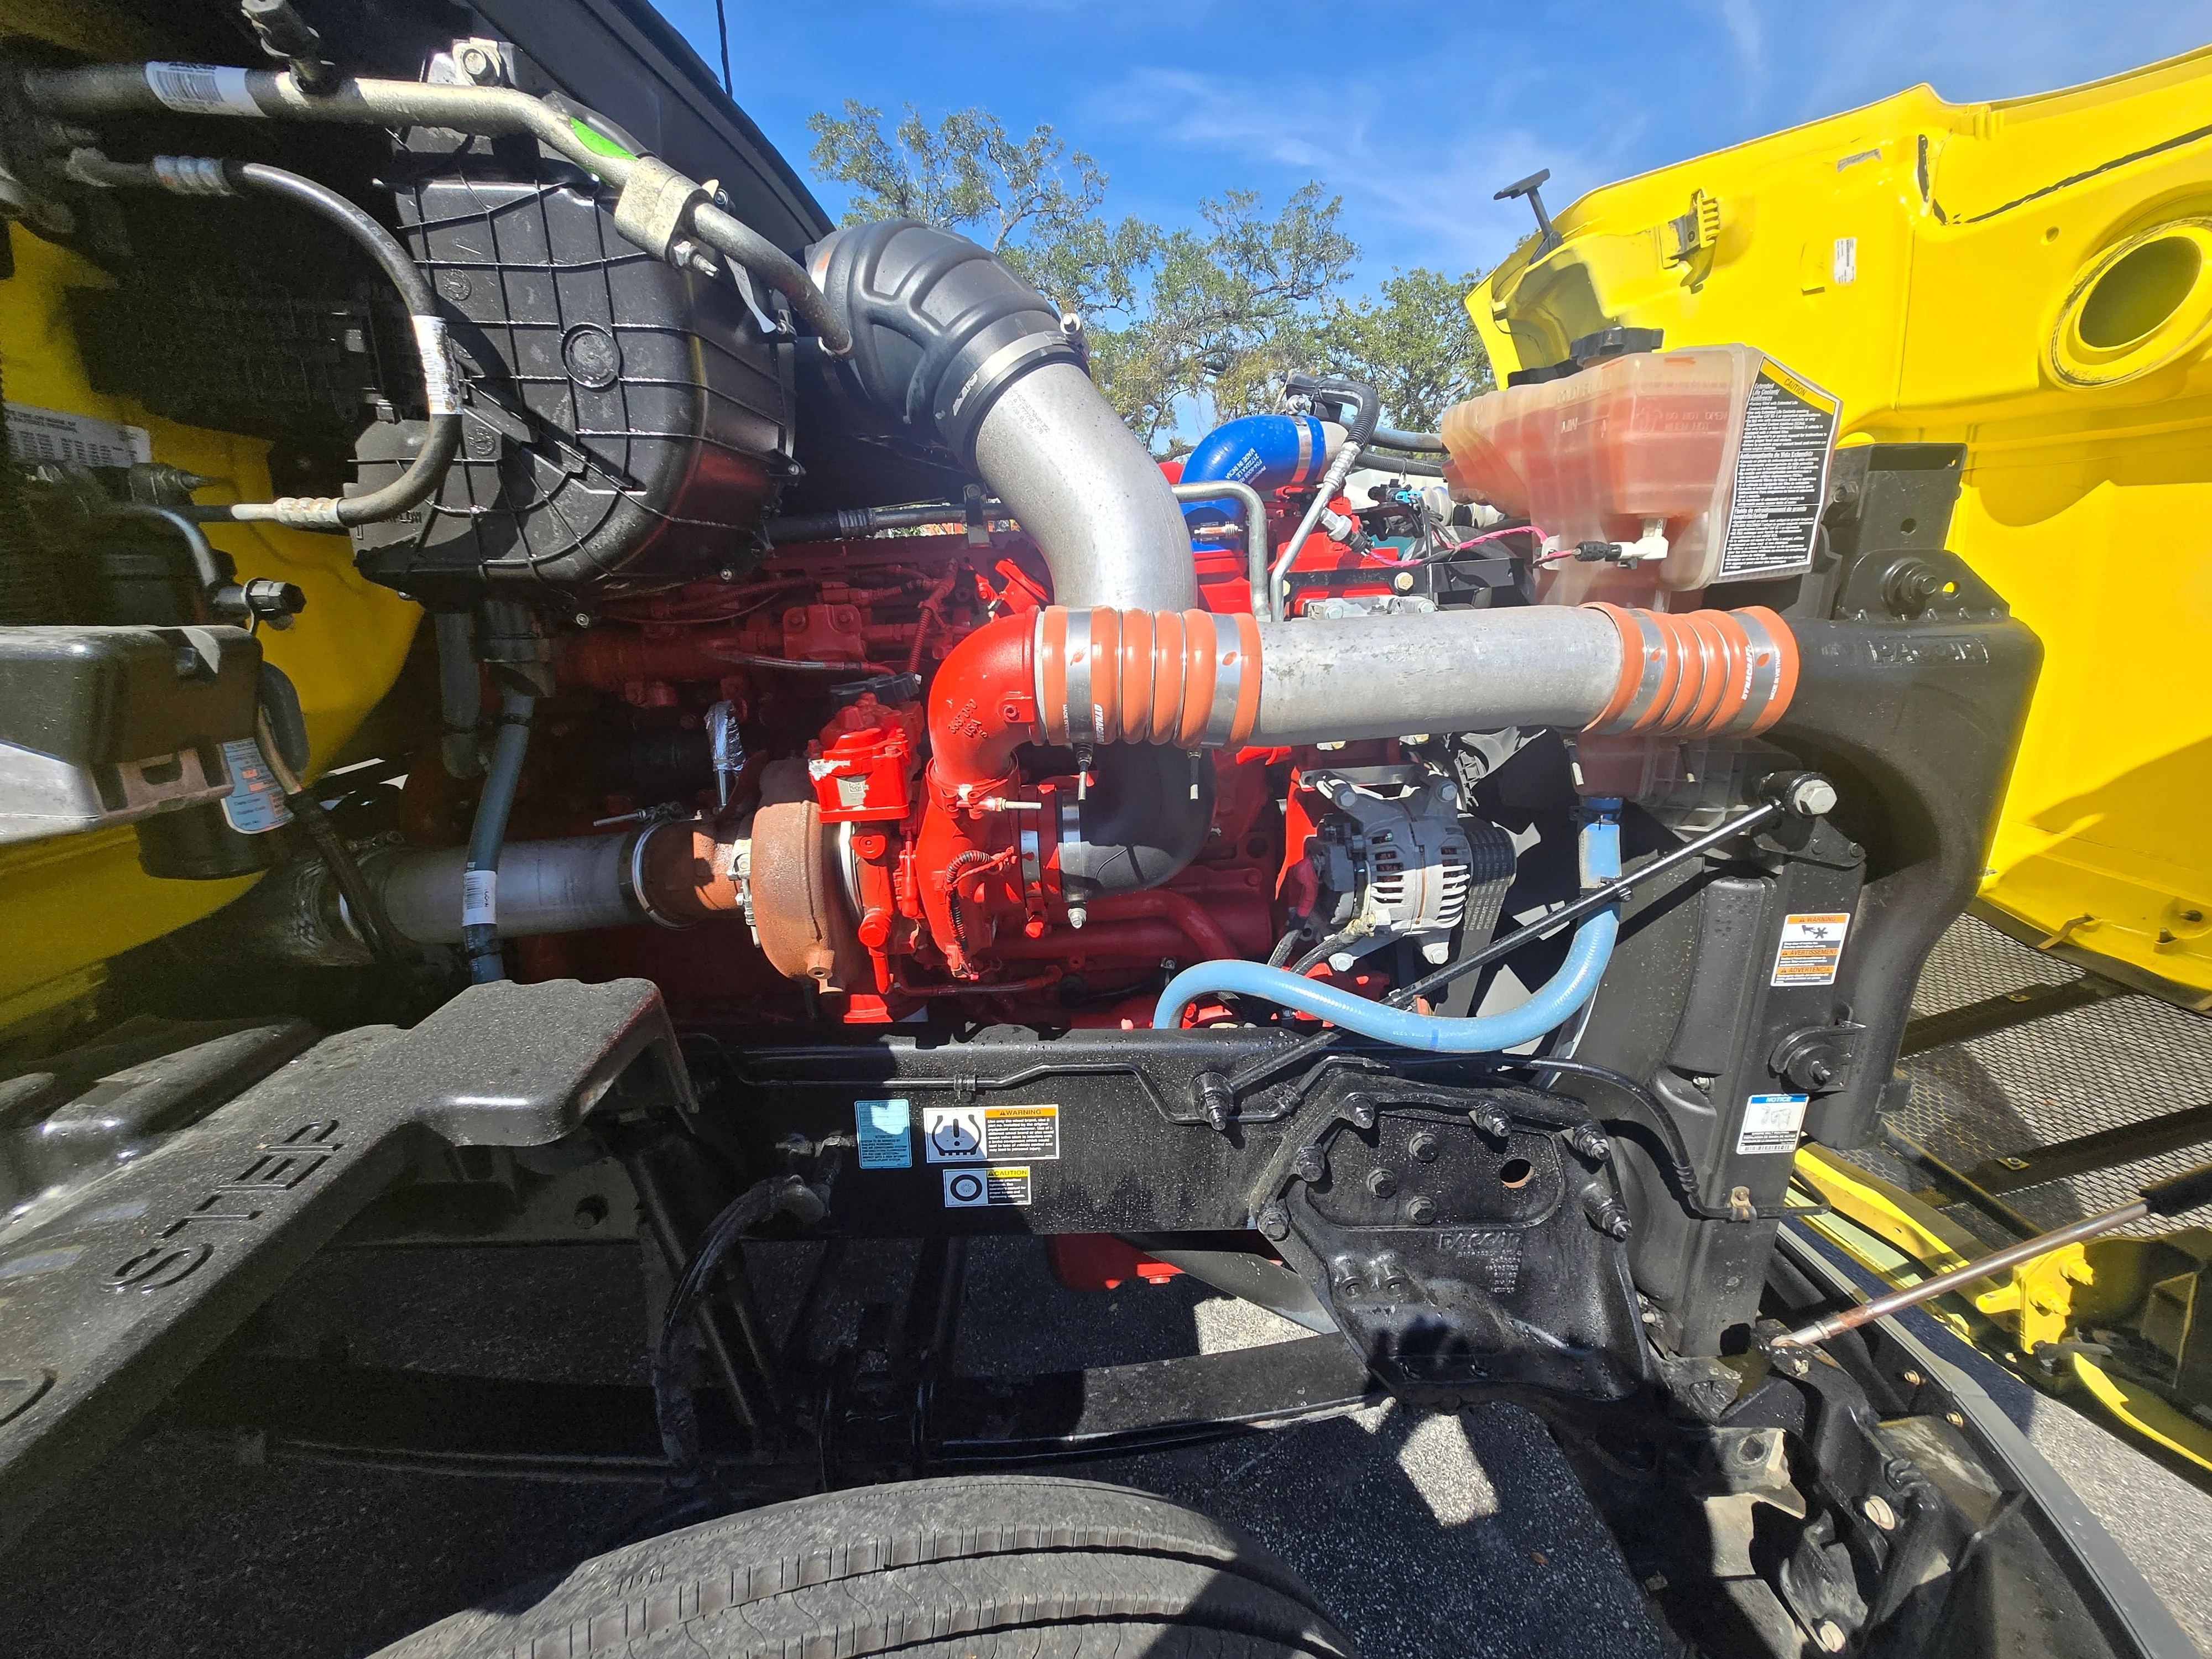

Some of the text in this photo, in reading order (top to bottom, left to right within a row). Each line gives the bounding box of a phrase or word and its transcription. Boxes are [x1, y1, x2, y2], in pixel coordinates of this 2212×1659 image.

[1783, 378, 1807, 397] CAUTION
[1241, 447, 1255, 463] MADE
[1225, 466, 1239, 479] INDIA
[1768, 684, 1778, 700] MADE
[962, 718, 982, 738] USA
[99, 1119, 345, 1293] STEP
